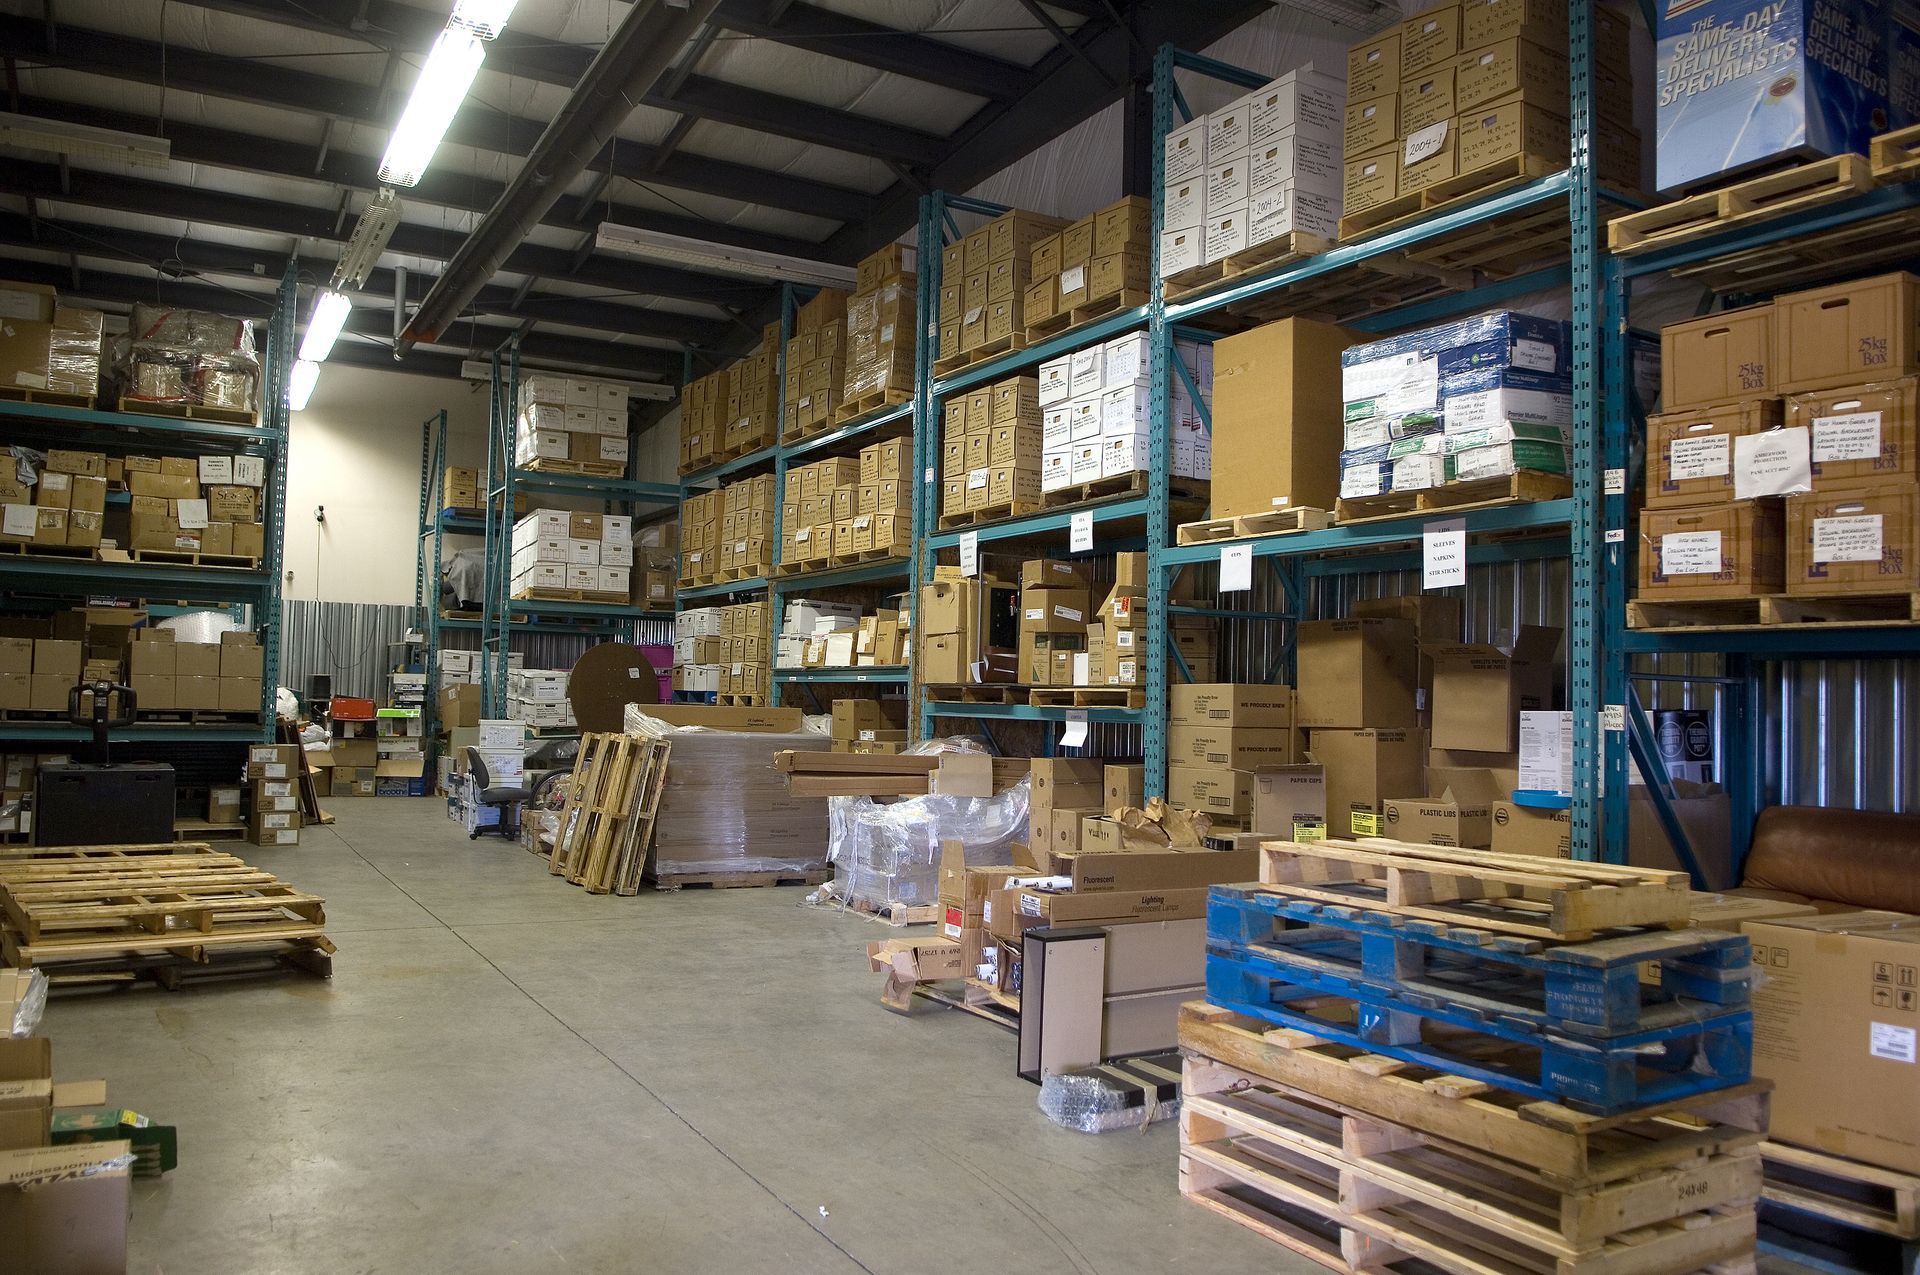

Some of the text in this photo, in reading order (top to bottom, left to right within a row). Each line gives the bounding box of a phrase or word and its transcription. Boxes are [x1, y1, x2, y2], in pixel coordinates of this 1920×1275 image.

[1673, 0, 1787, 62] SAME-DAY
[1691, 14, 1715, 34] THE
[1814, 1, 1881, 49] SAME-DAY
[1809, 19, 1873, 67] DELIVERY
[1667, 29, 1769, 85] DELIVERY
[1660, 37, 1798, 107] SPECIALISTS
[1806, 37, 1887, 96] SPECIALISTS
[1858, 336, 1888, 353] 25kg
[1863, 351, 1888, 366] Box
[1738, 362, 1764, 377] 25kg
[1742, 376, 1765, 390] Box
[1432, 540, 1456, 549] SLEEVES
[1432, 554, 1456, 562] NAPKINS
[1420, 808, 1456, 818] PLASTIC LIDS
[1460, 810, 1479, 818] PLASTIC
[1083, 876, 1115, 884] Fluorescent
[1132, 903, 1180, 913] Fluorescent Lamps
[1141, 896, 1165, 905] Lighting
